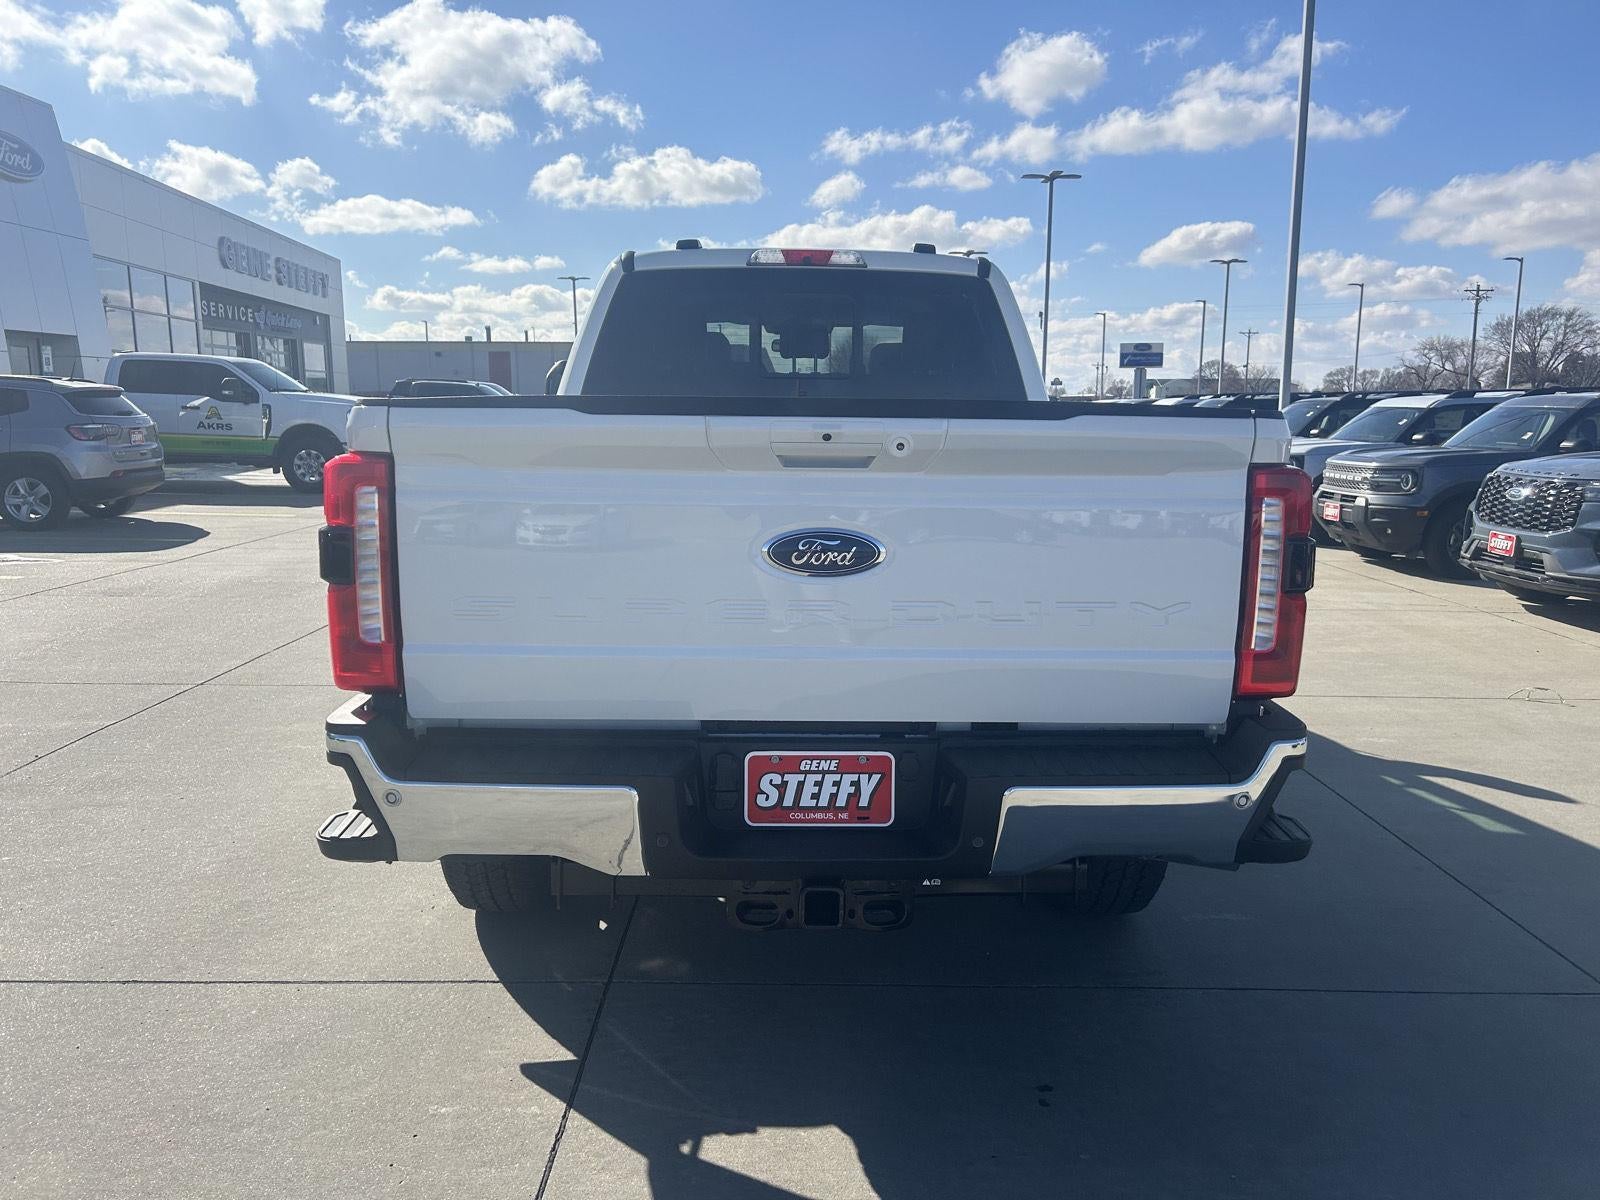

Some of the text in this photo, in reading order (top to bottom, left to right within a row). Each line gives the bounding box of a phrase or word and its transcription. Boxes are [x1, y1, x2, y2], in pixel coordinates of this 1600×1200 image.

[0, 138, 33, 170] Ford
[218, 236, 330, 298] GENE STEFFY
[201, 300, 254, 322] SERVICE
[791, 538, 857, 565] Ford
[799, 759, 840, 771] GENE
[755, 772, 883, 808] STEFFY
[789, 812, 836, 821] COLUMBUS,
[838, 812, 849, 820] NE
